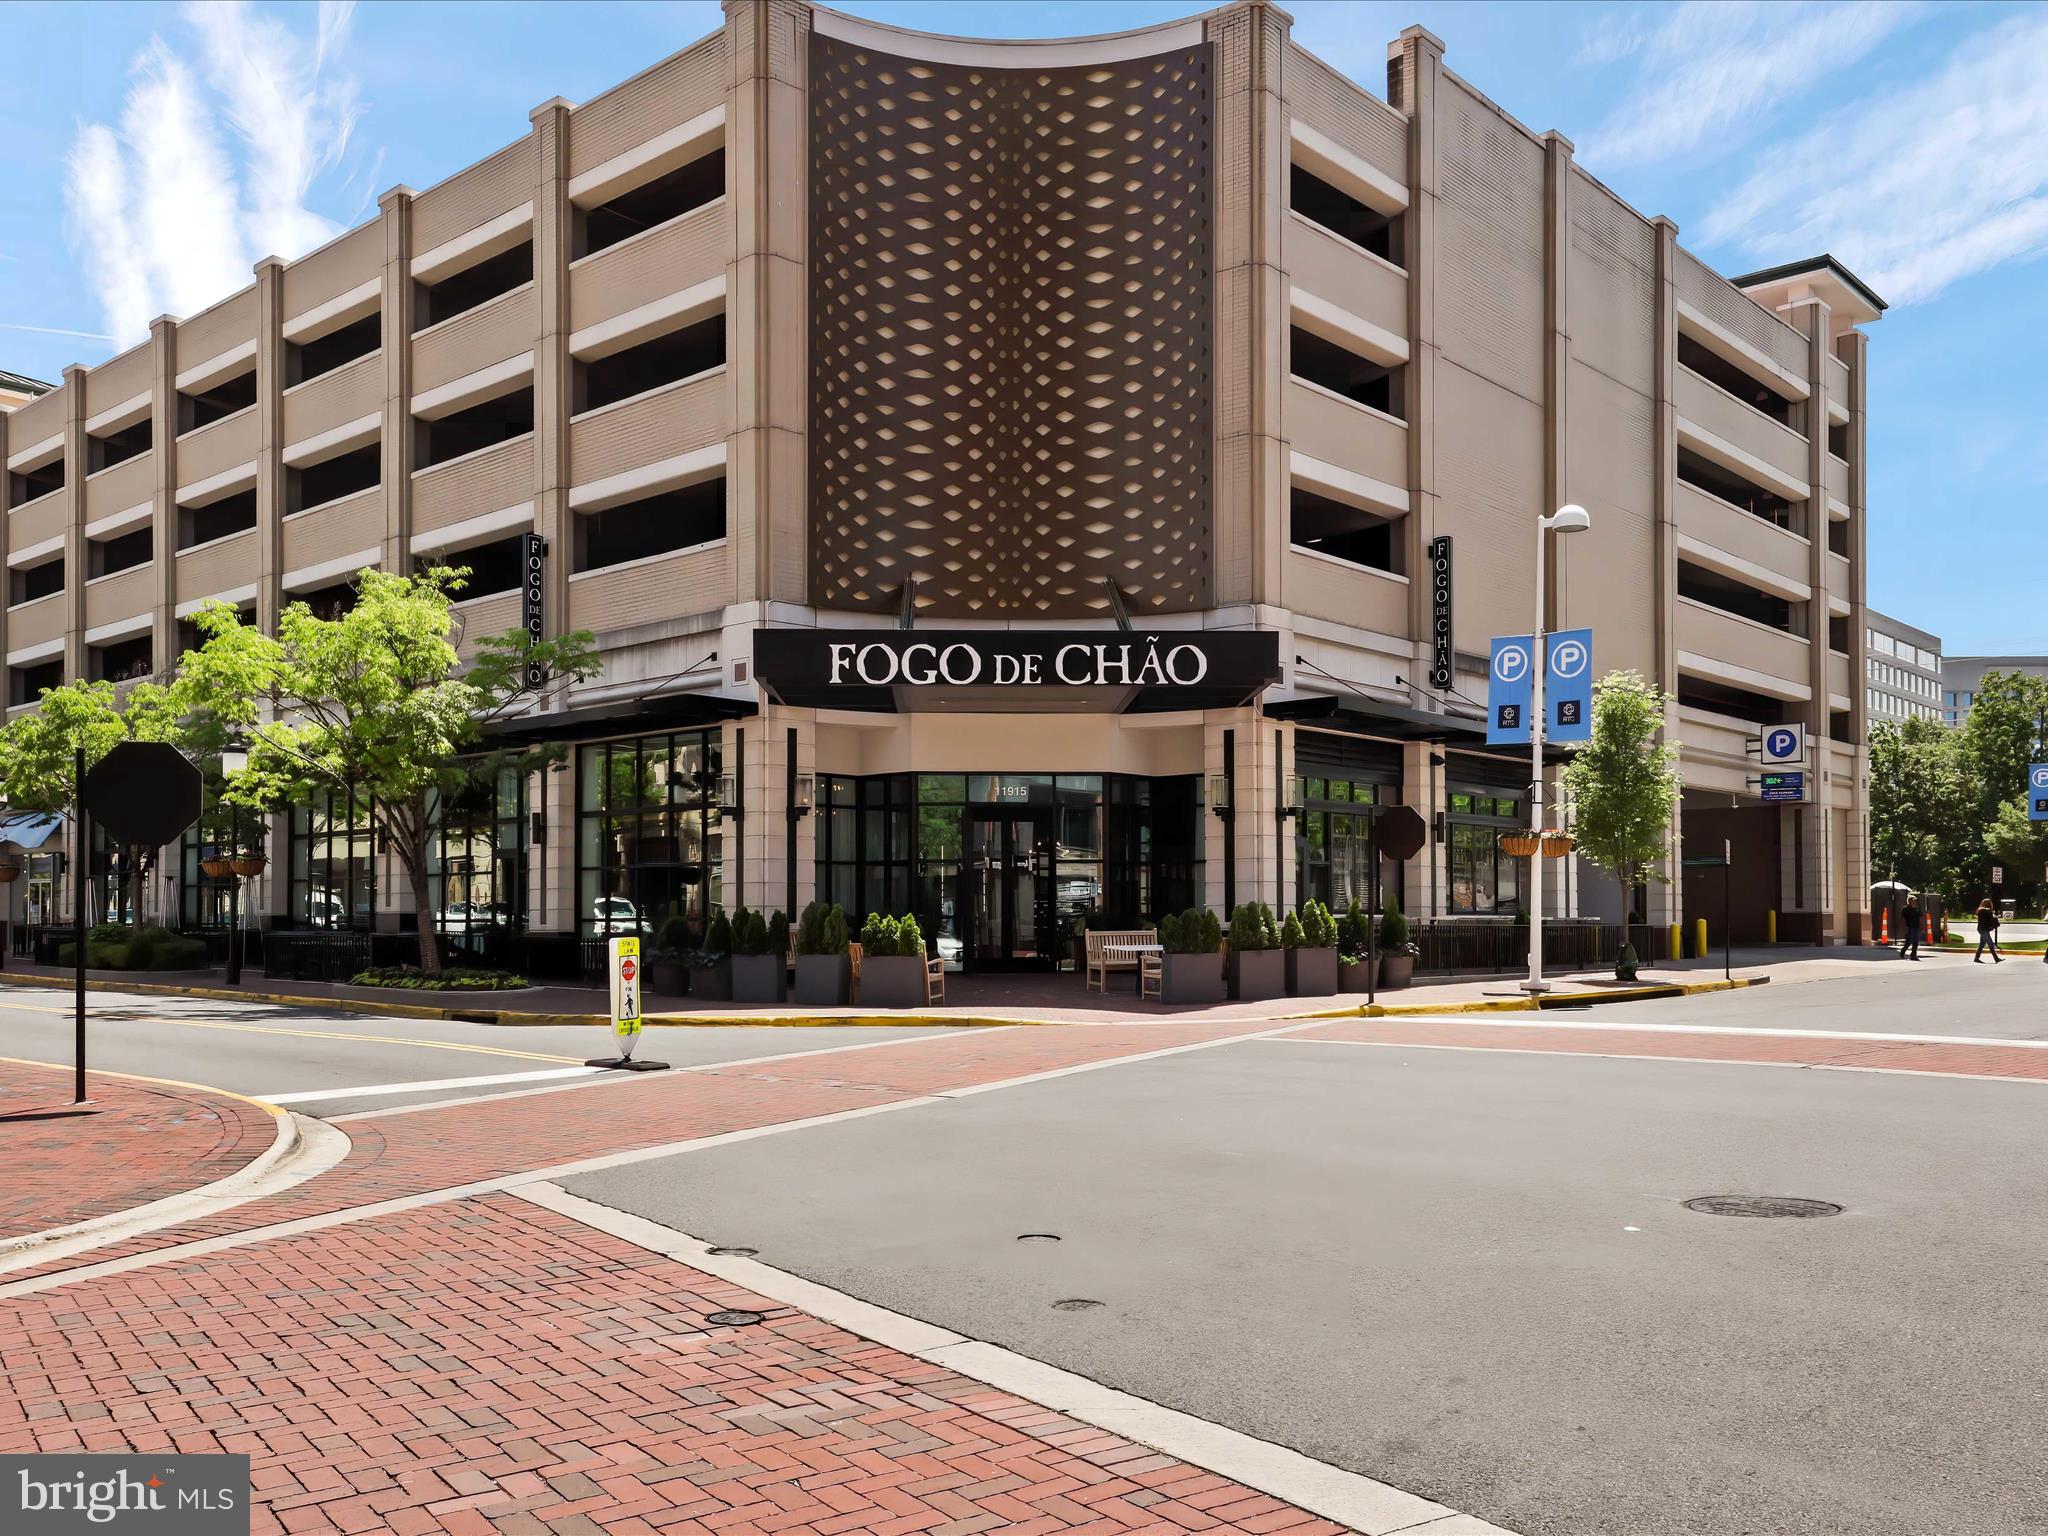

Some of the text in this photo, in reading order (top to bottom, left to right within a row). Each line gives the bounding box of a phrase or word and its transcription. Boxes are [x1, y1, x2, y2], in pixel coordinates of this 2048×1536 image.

[529, 541, 541, 682] FOGO DE CHO
[1436, 543, 1448, 682] FOGO DE CHÃO
[828, 635, 1208, 686] FOGO DE CHÃO
[1503, 652, 1521, 676] P
[1560, 647, 1580, 672] P
[1776, 734, 1790, 752] P
[994, 786, 1027, 796] 11915
[622, 966, 635, 974] STOP
